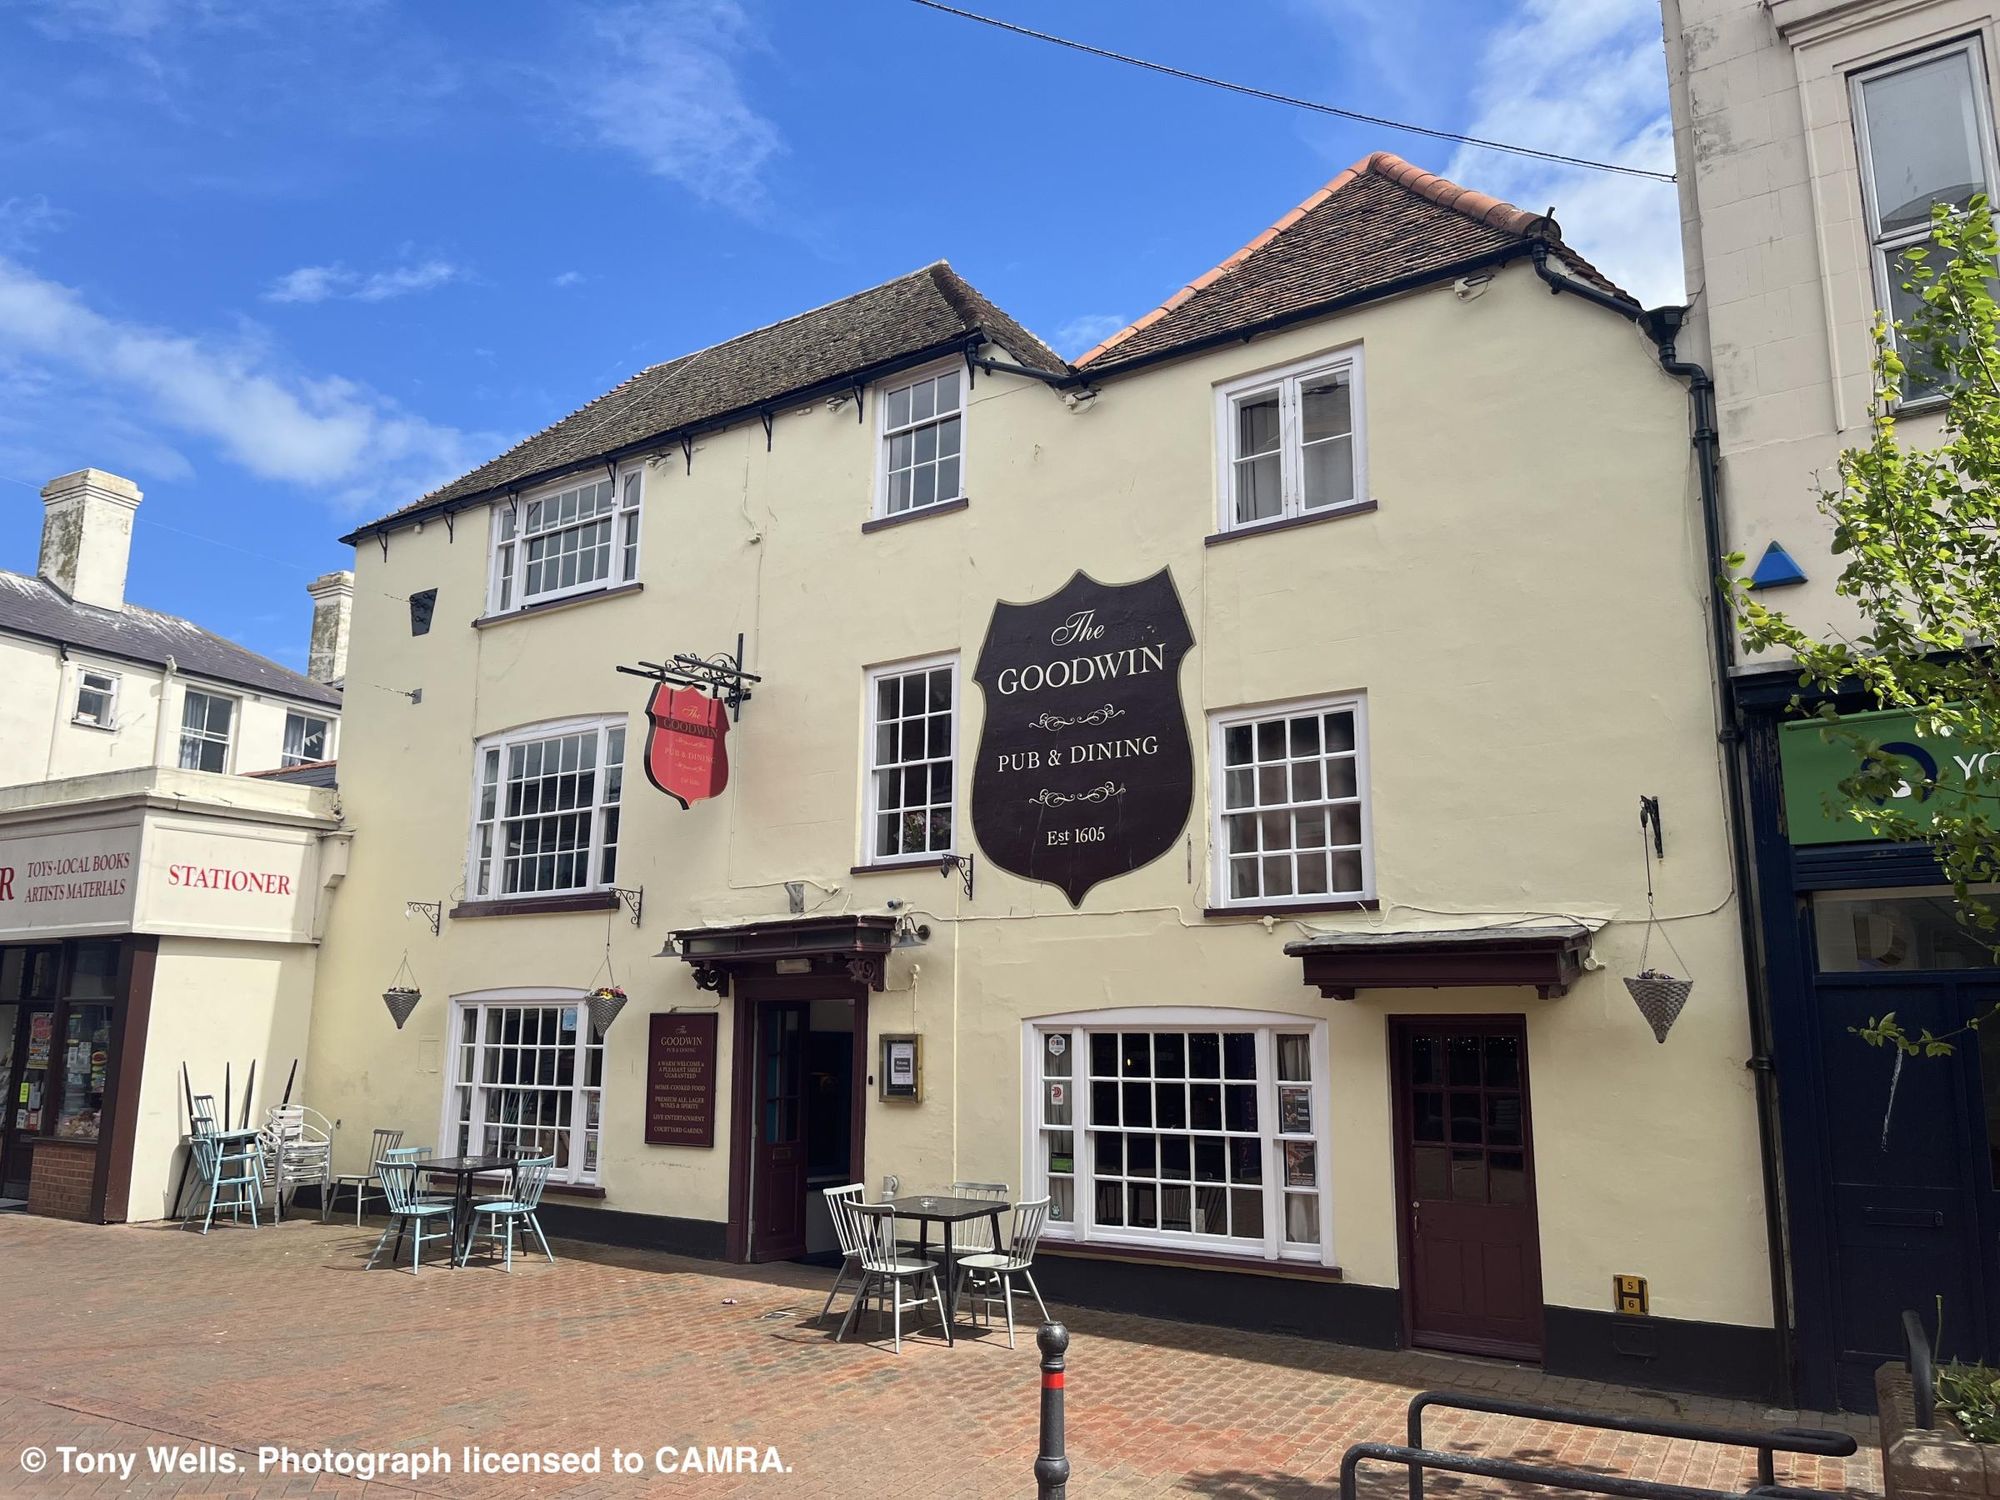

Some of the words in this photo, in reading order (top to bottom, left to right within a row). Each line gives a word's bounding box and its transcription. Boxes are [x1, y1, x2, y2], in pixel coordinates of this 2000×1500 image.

[1051, 608, 1105, 646] The
[997, 643, 1166, 695] GOODWIN
[663, 718, 718, 738] GOODWIN
[998, 752, 1040, 772] PUB
[1047, 750, 1061, 767] &
[1070, 736, 1159, 764] DINING
[1046, 829, 1070, 846] Est
[1074, 826, 1105, 844] 1605
[93, 852, 130, 872] BOOKS
[168, 864, 292, 895] STATIONER
[24, 884, 65, 904] ARTISTS
[66, 878, 126, 900] MATERIALS
[660, 1036, 703, 1046] GOODWIN
[1627, 1281, 1633, 1290] 5
[1628, 1299, 1635, 1309] 6
